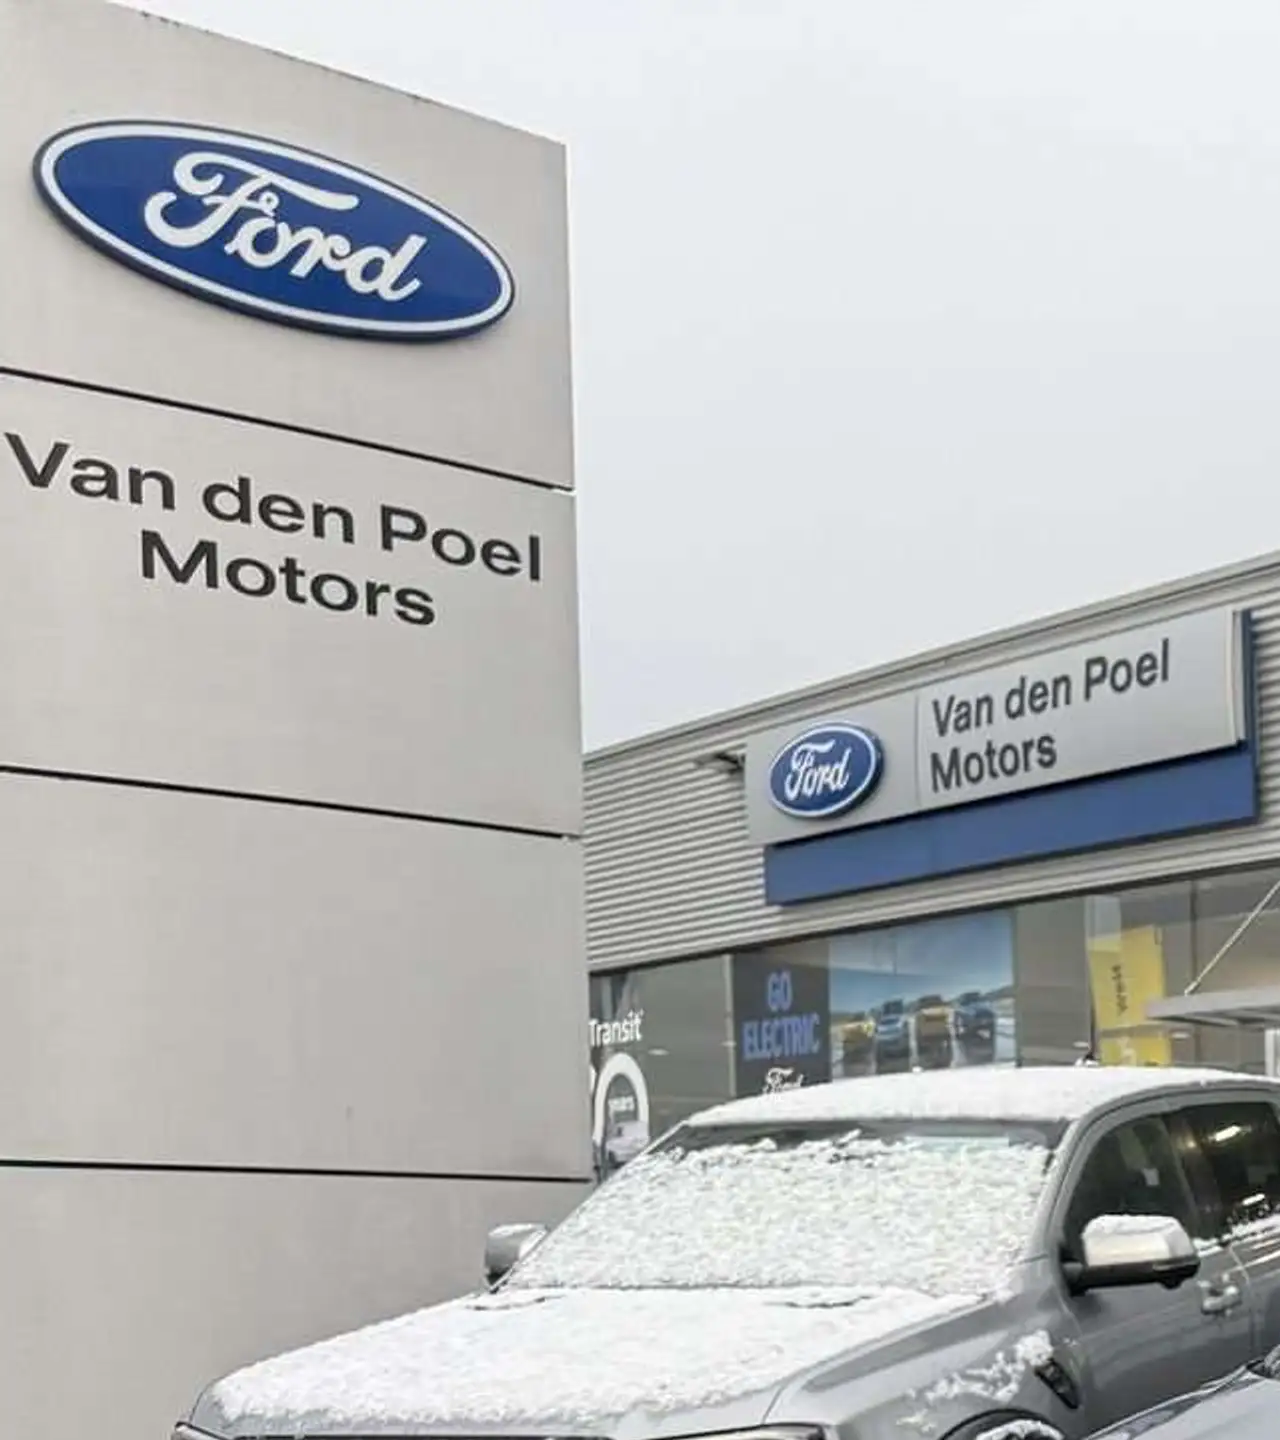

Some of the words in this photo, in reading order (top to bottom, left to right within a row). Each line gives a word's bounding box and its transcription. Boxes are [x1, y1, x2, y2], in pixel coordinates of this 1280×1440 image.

[144, 152, 428, 301] Ford
[4, 431, 176, 512] Van
[201, 476, 354, 543] den
[380, 505, 541, 582] Poel
[140, 529, 436, 625] Motors
[932, 694, 993, 739] Van
[1004, 675, 1071, 720] den
[1083, 639, 1170, 702] Poel
[783, 740, 851, 800] Ford
[930, 735, 1058, 793] Motors
[767, 971, 793, 1011] GO
[588, 1010, 643, 1047] Transit
[742, 1012, 821, 1061] ELECTRIC
